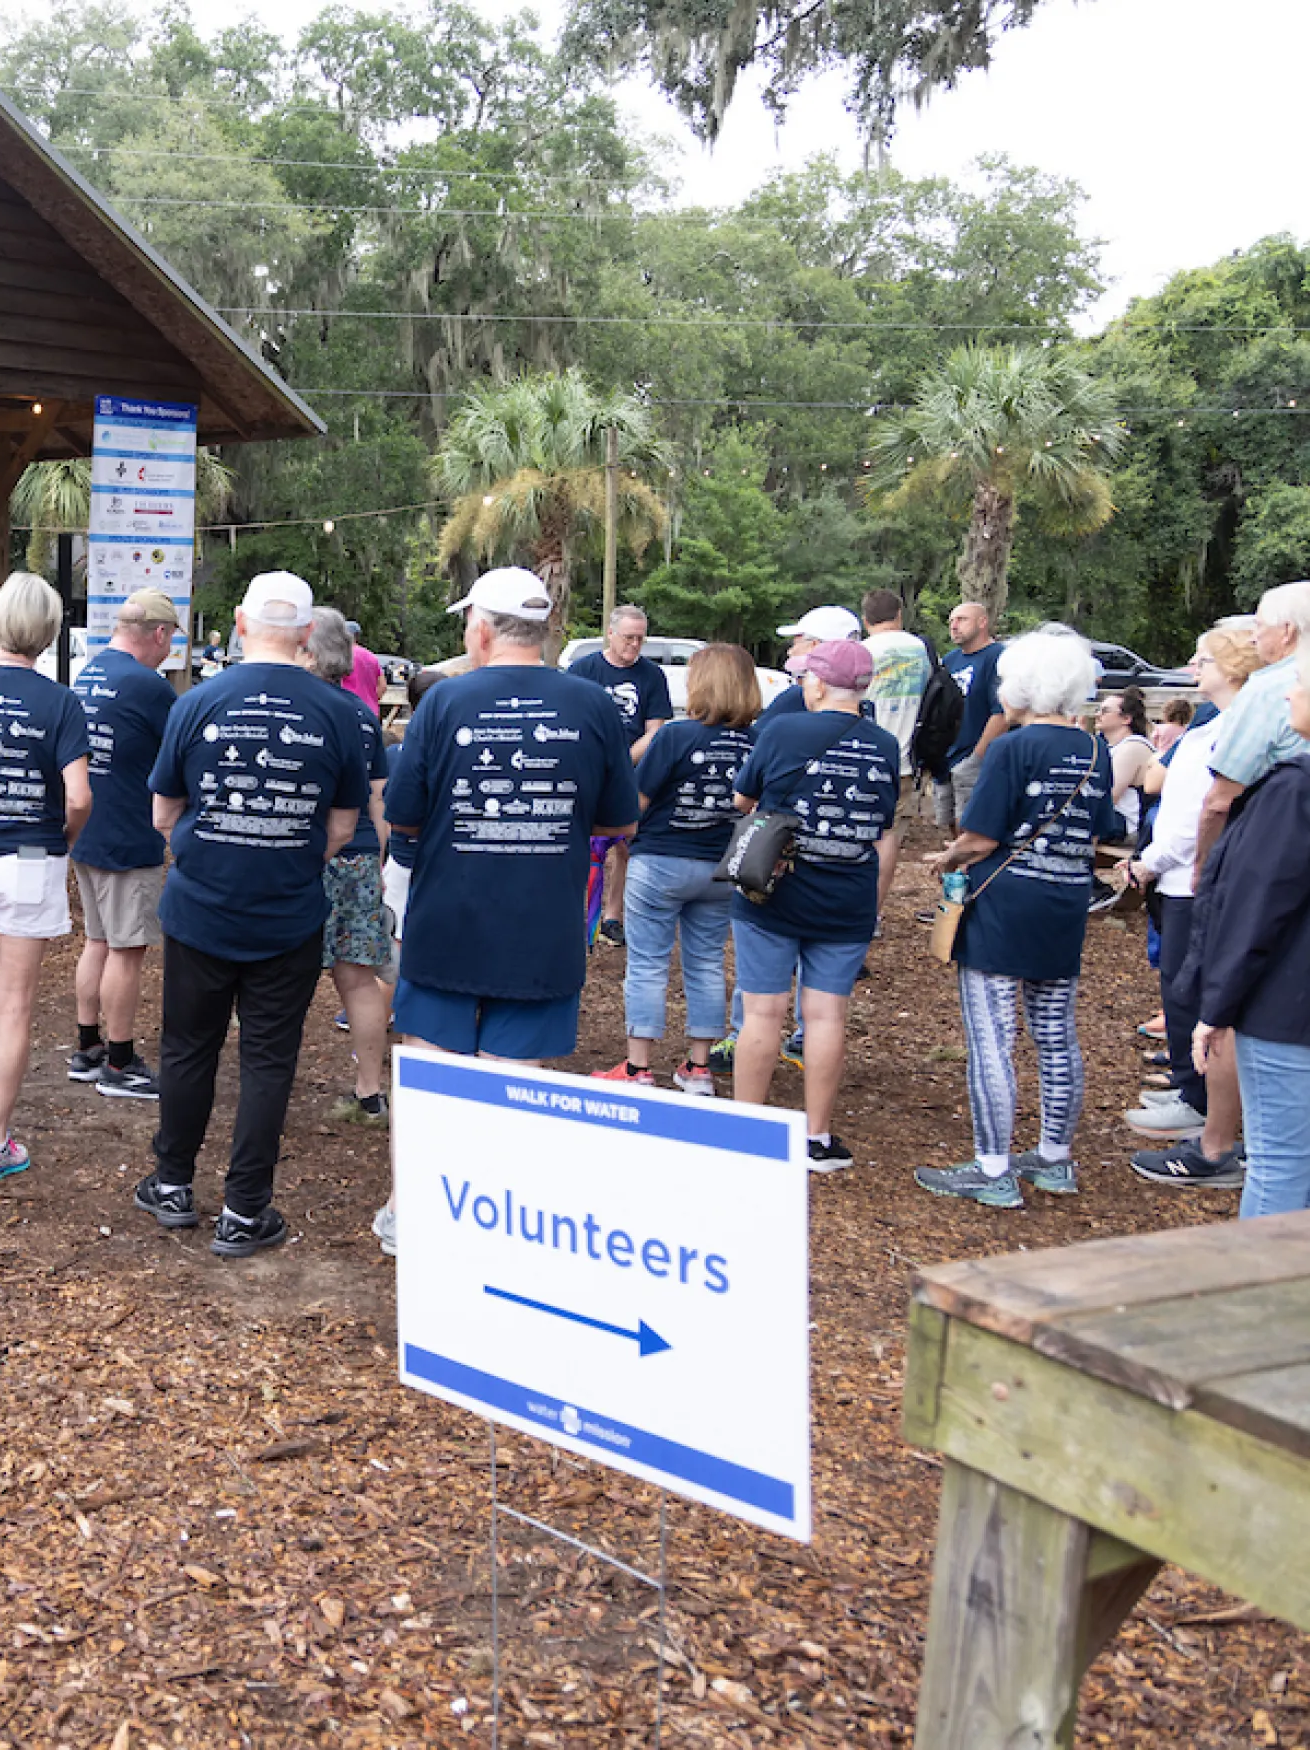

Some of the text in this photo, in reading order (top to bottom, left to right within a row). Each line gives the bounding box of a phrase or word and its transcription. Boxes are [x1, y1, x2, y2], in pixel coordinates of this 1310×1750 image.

[505, 1085, 639, 1124] WALK FOR WATER
[441, 1174, 730, 1294] Volunteers
